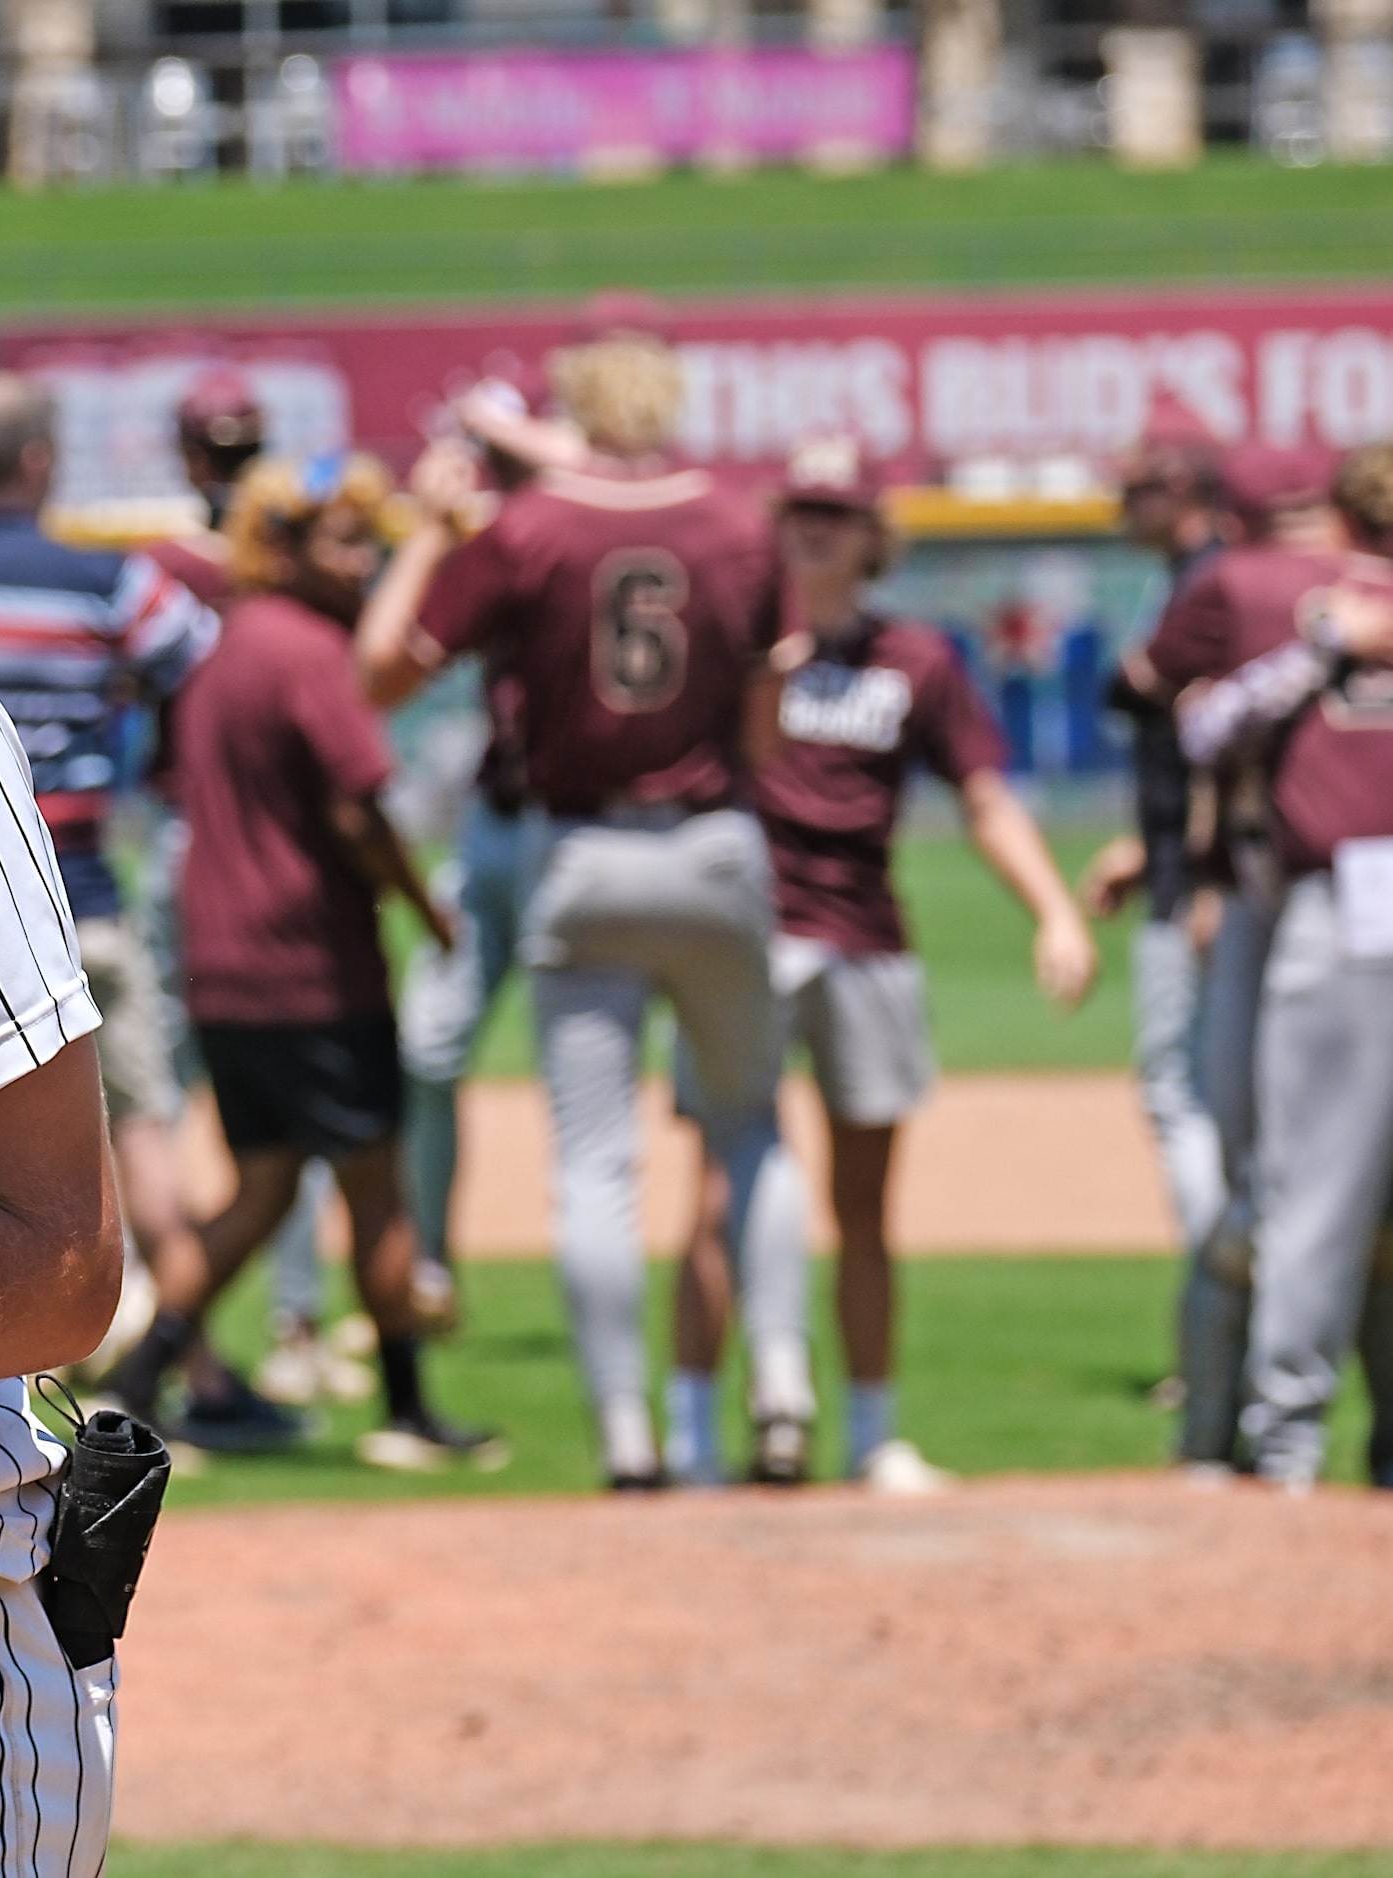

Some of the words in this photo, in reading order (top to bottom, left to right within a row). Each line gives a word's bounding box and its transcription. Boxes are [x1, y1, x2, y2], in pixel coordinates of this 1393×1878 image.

[675, 341, 909, 460] THIS
[919, 331, 1247, 455] BUD'S
[590, 545, 689, 715] 6
